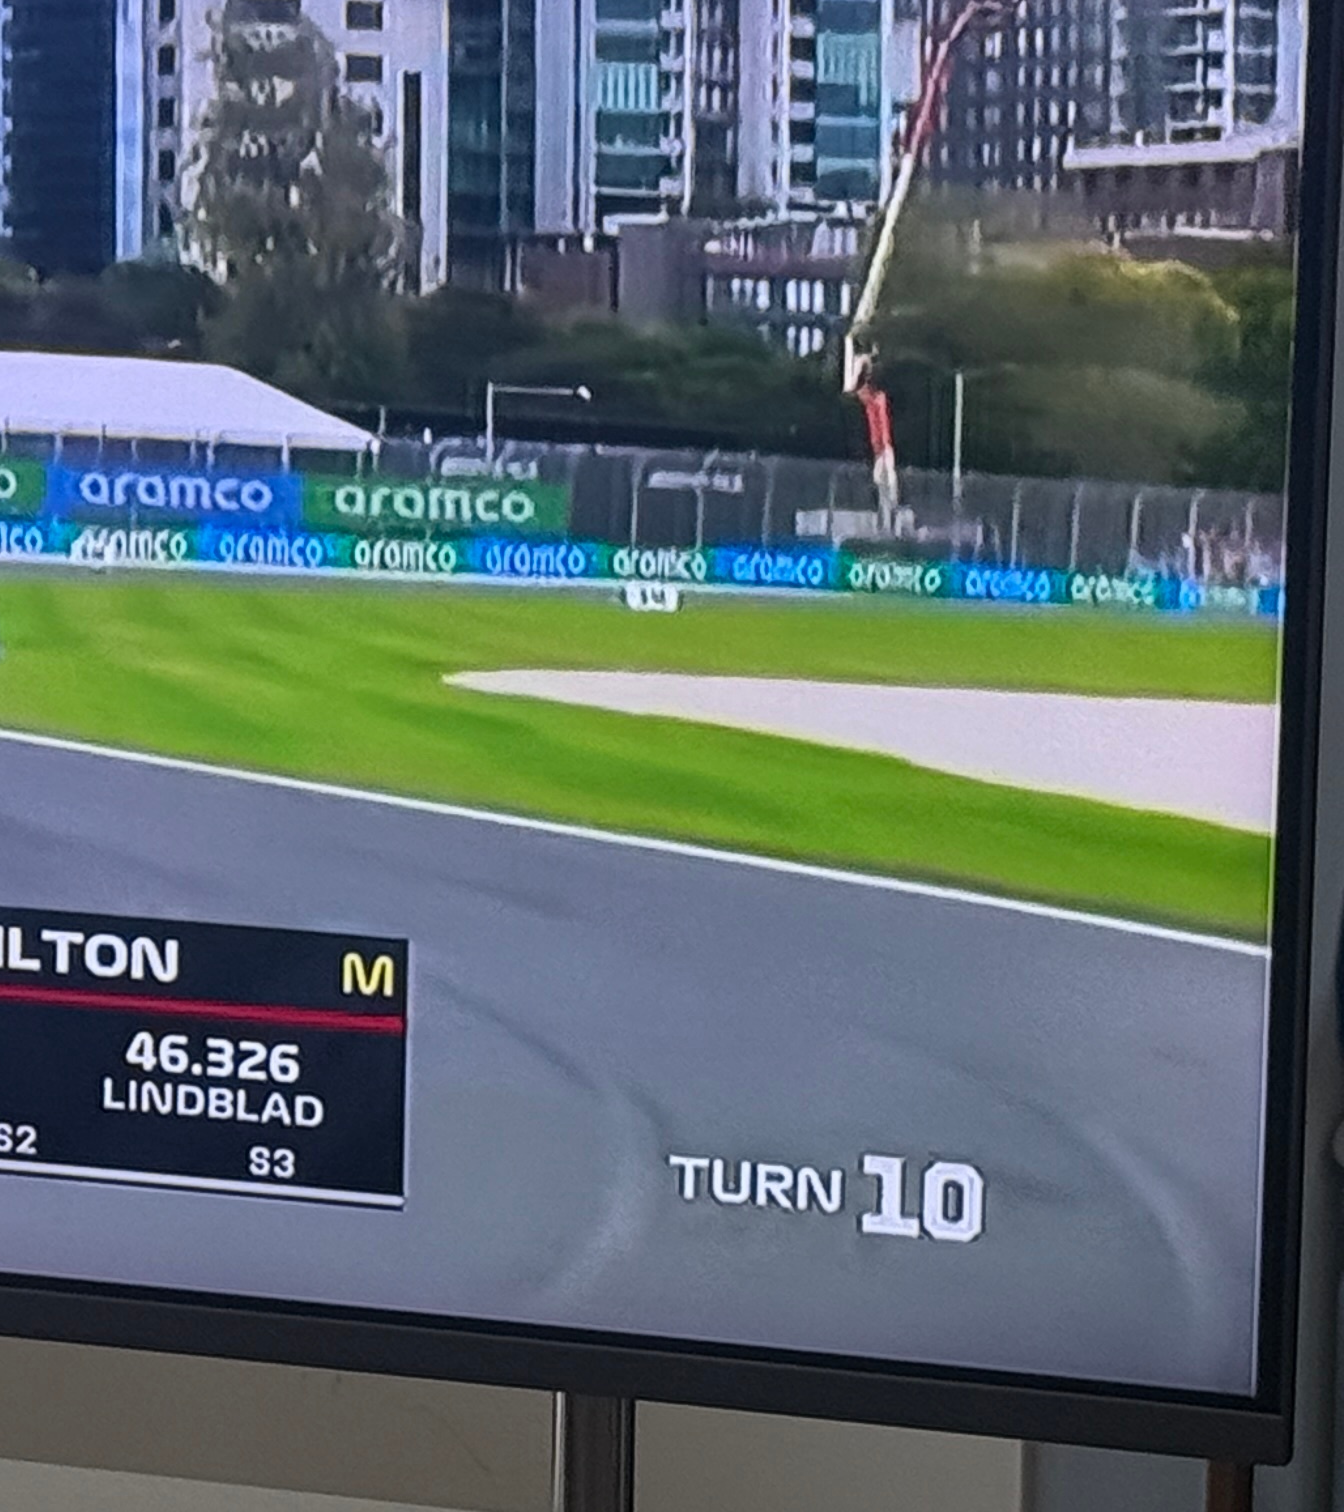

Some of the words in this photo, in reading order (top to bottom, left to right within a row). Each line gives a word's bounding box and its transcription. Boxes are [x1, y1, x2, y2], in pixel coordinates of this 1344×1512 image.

[79, 469, 272, 512] aramco
[334, 480, 534, 525] aramco
[219, 530, 323, 569] aramco
[353, 536, 457, 572] aramco
[342, 952, 395, 997] M
[126, 1031, 300, 1083] 46.326
[103, 1077, 324, 1129] LINDBLAD
[249, 1147, 295, 1179] S3
[668, 1155, 843, 1214] TURN
[861, 1155, 984, 1242] 10
